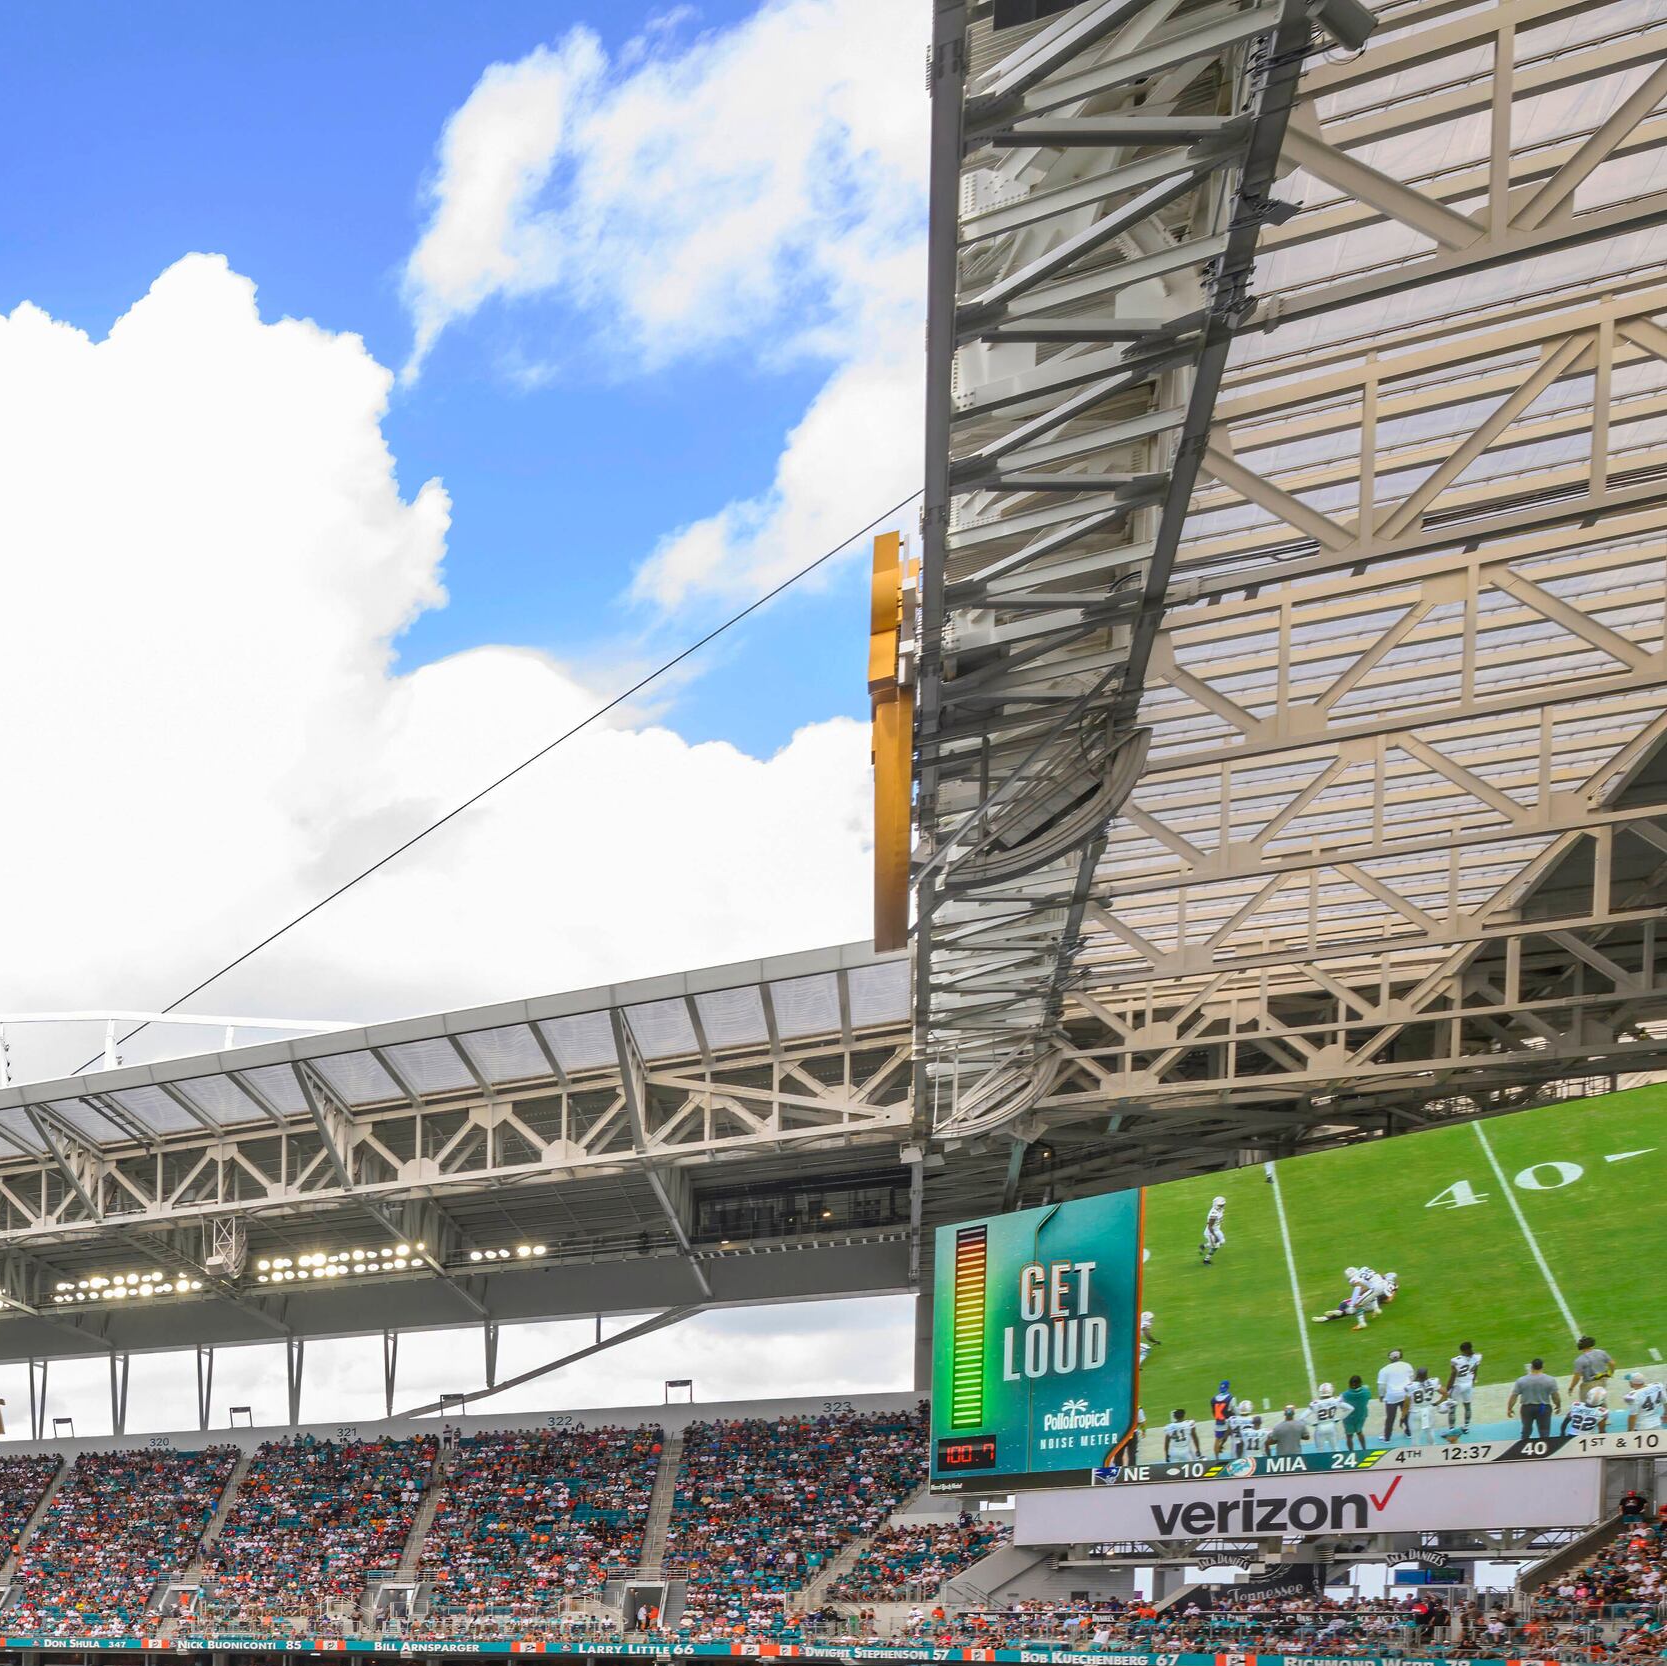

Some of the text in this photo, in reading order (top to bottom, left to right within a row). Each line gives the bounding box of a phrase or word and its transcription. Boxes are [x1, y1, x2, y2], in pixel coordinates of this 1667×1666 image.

[1425, 1161, 1584, 1210] 40
[1020, 1261, 1097, 1322] GET
[1003, 1316, 1107, 1382] LOUD
[822, 1401, 853, 1412] 323
[547, 1416, 573, 1427] 322
[149, 1437, 171, 1447] 320
[1040, 1433, 1118, 1450] NOISE METER
[1521, 1441, 1548, 1456] 40
[1579, 1437, 1607, 1452] 1ST
[1634, 1433, 1659, 1449] 10
[946, 1444, 995, 1464] 100.7
[1395, 1444, 1492, 1464] 4TH 12:37
[1266, 1453, 1357, 1473] MIA 24
[1124, 1462, 1204, 1482] NE 10
[1150, 1488, 1369, 1536] verizon
[1227, 1582, 1306, 1605] Tennessee
[43, 1638, 127, 1649] DON SHULA 347
[177, 1639, 303, 1651] NICK BUONICONTI 85
[374, 1641, 480, 1653] BILL ARNSPARGER
[578, 1643, 695, 1655] LARRY LITTLE 66
[804, 1646, 950, 1661] DWIGHT STEPHENSON 57
[1020, 1651, 1180, 1666] BOB KUECHENBERG 67
